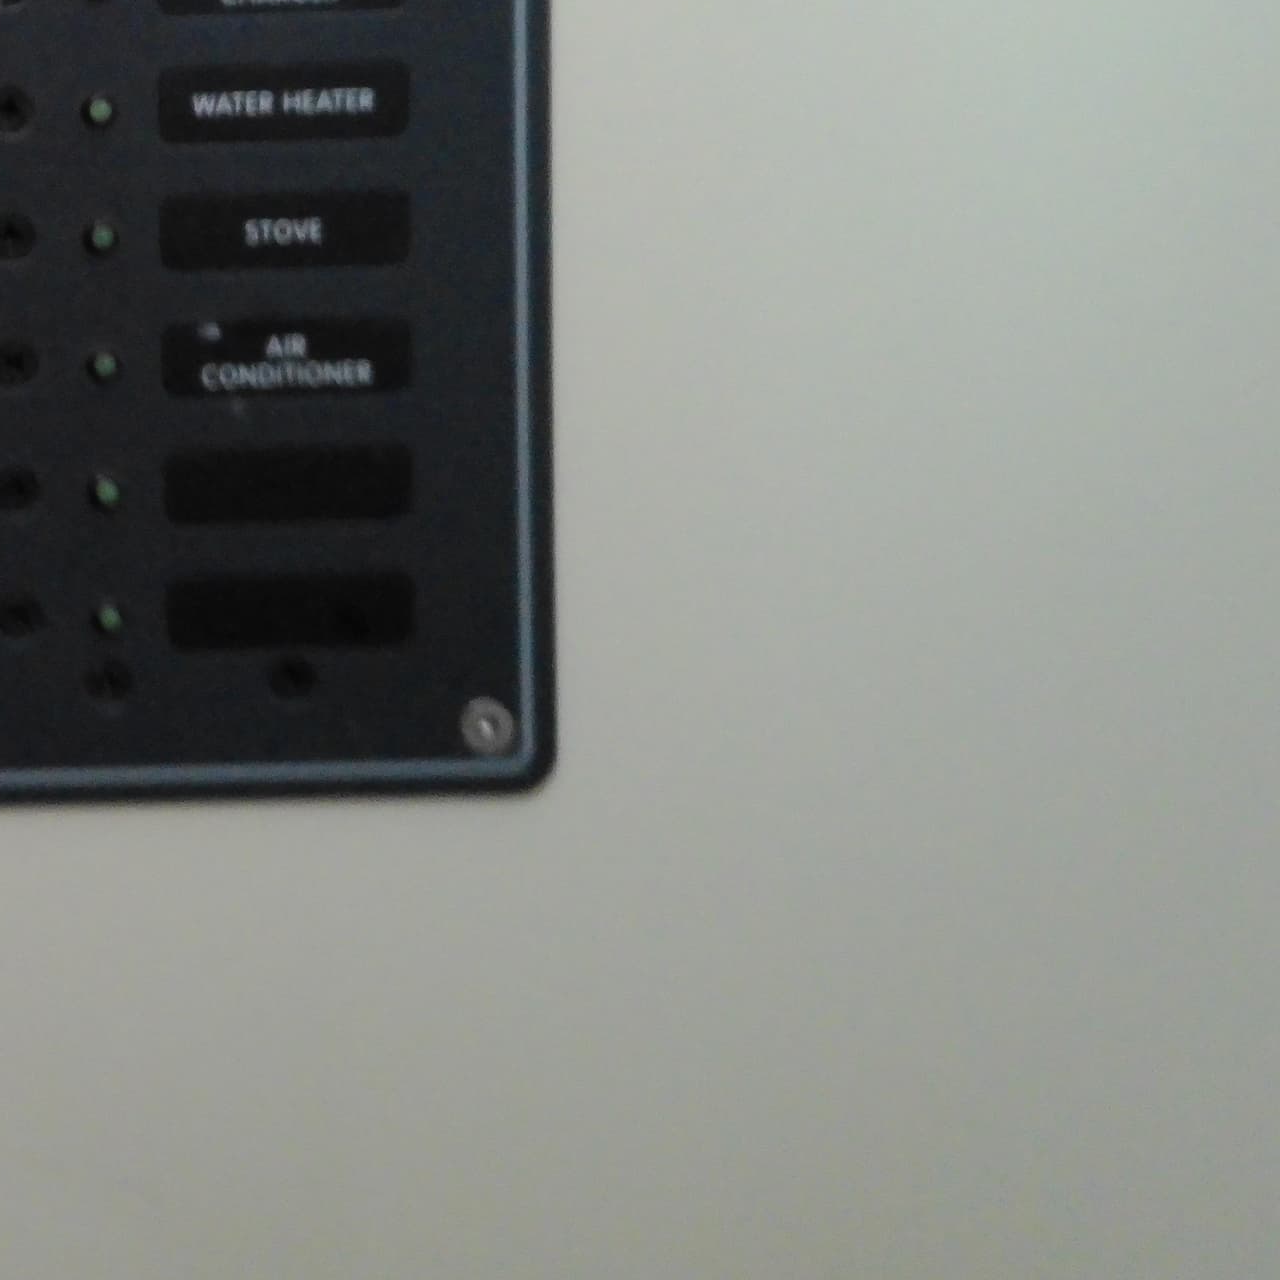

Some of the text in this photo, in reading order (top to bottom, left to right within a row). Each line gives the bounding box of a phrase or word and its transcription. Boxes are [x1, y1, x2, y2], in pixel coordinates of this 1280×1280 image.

[192, 87, 376, 118] WATER HEATER
[244, 217, 322, 246] STOVE
[264, 333, 307, 358] AIR
[200, 358, 375, 391] CONDITIONER
